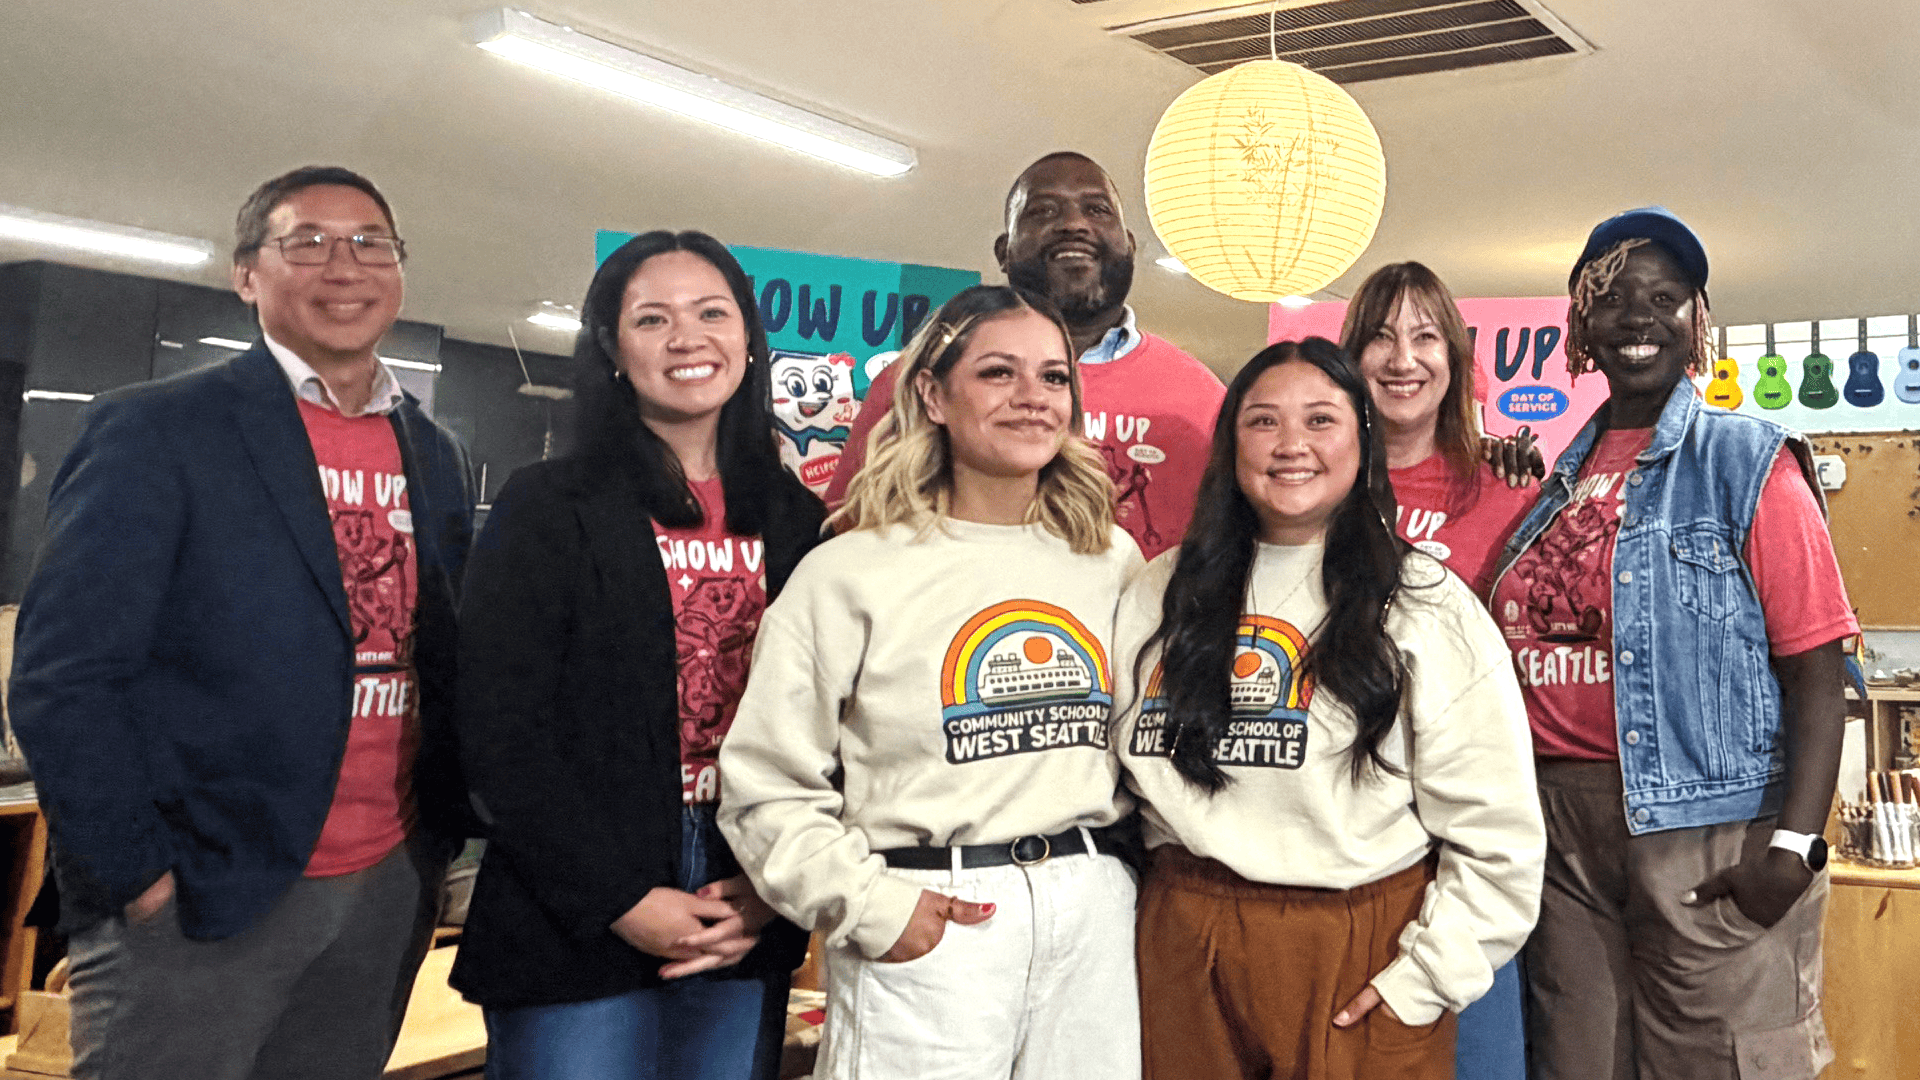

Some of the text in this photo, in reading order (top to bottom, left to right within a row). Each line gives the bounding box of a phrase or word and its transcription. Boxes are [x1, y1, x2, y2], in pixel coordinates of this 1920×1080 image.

[862, 289, 930, 348] UP
[1495, 326, 1561, 382] UP
[1508, 402, 1557, 413] SERVICE
[1510, 392, 1555, 402] DAY OF
[1115, 414, 1151, 443] UP
[375, 471, 407, 508] UP
[1817, 462, 1831, 487] E
[1406, 507, 1448, 540] UP
[656, 535, 765, 573] SHOW U
[1518, 646, 1610, 687] SEATTLE
[947, 707, 1046, 735] COMMUNITY
[1228, 721, 1304, 739] SCHOOL OF
[952, 728, 1024, 761] WEST
[1212, 738, 1301, 766] EATTLE
